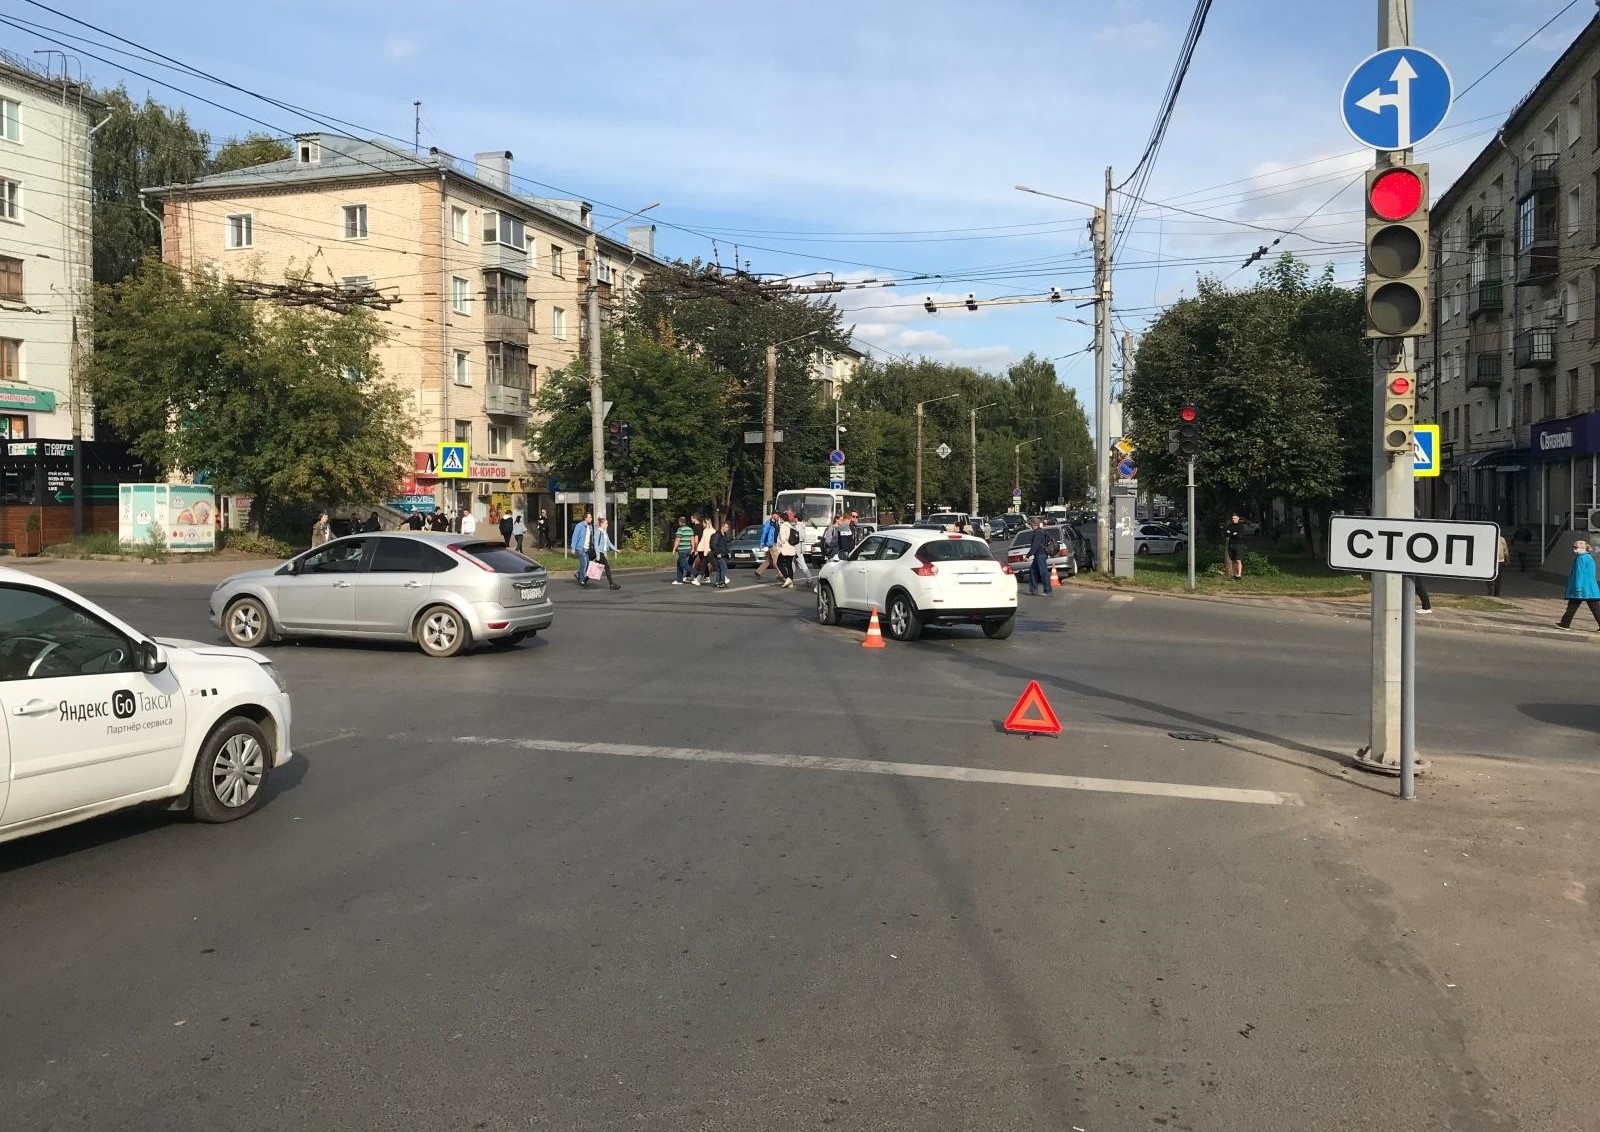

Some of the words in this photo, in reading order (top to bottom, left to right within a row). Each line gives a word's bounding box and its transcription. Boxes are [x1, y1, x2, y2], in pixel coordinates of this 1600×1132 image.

[1347, 529, 1475, 566] СТОП
[59, 700, 109, 722] Яндекс
[115, 693, 134, 715] Go
[137, 692, 172, 712] Такси
[107, 722, 142, 735] Партнёр
[142, 718, 173, 731] сервиса
